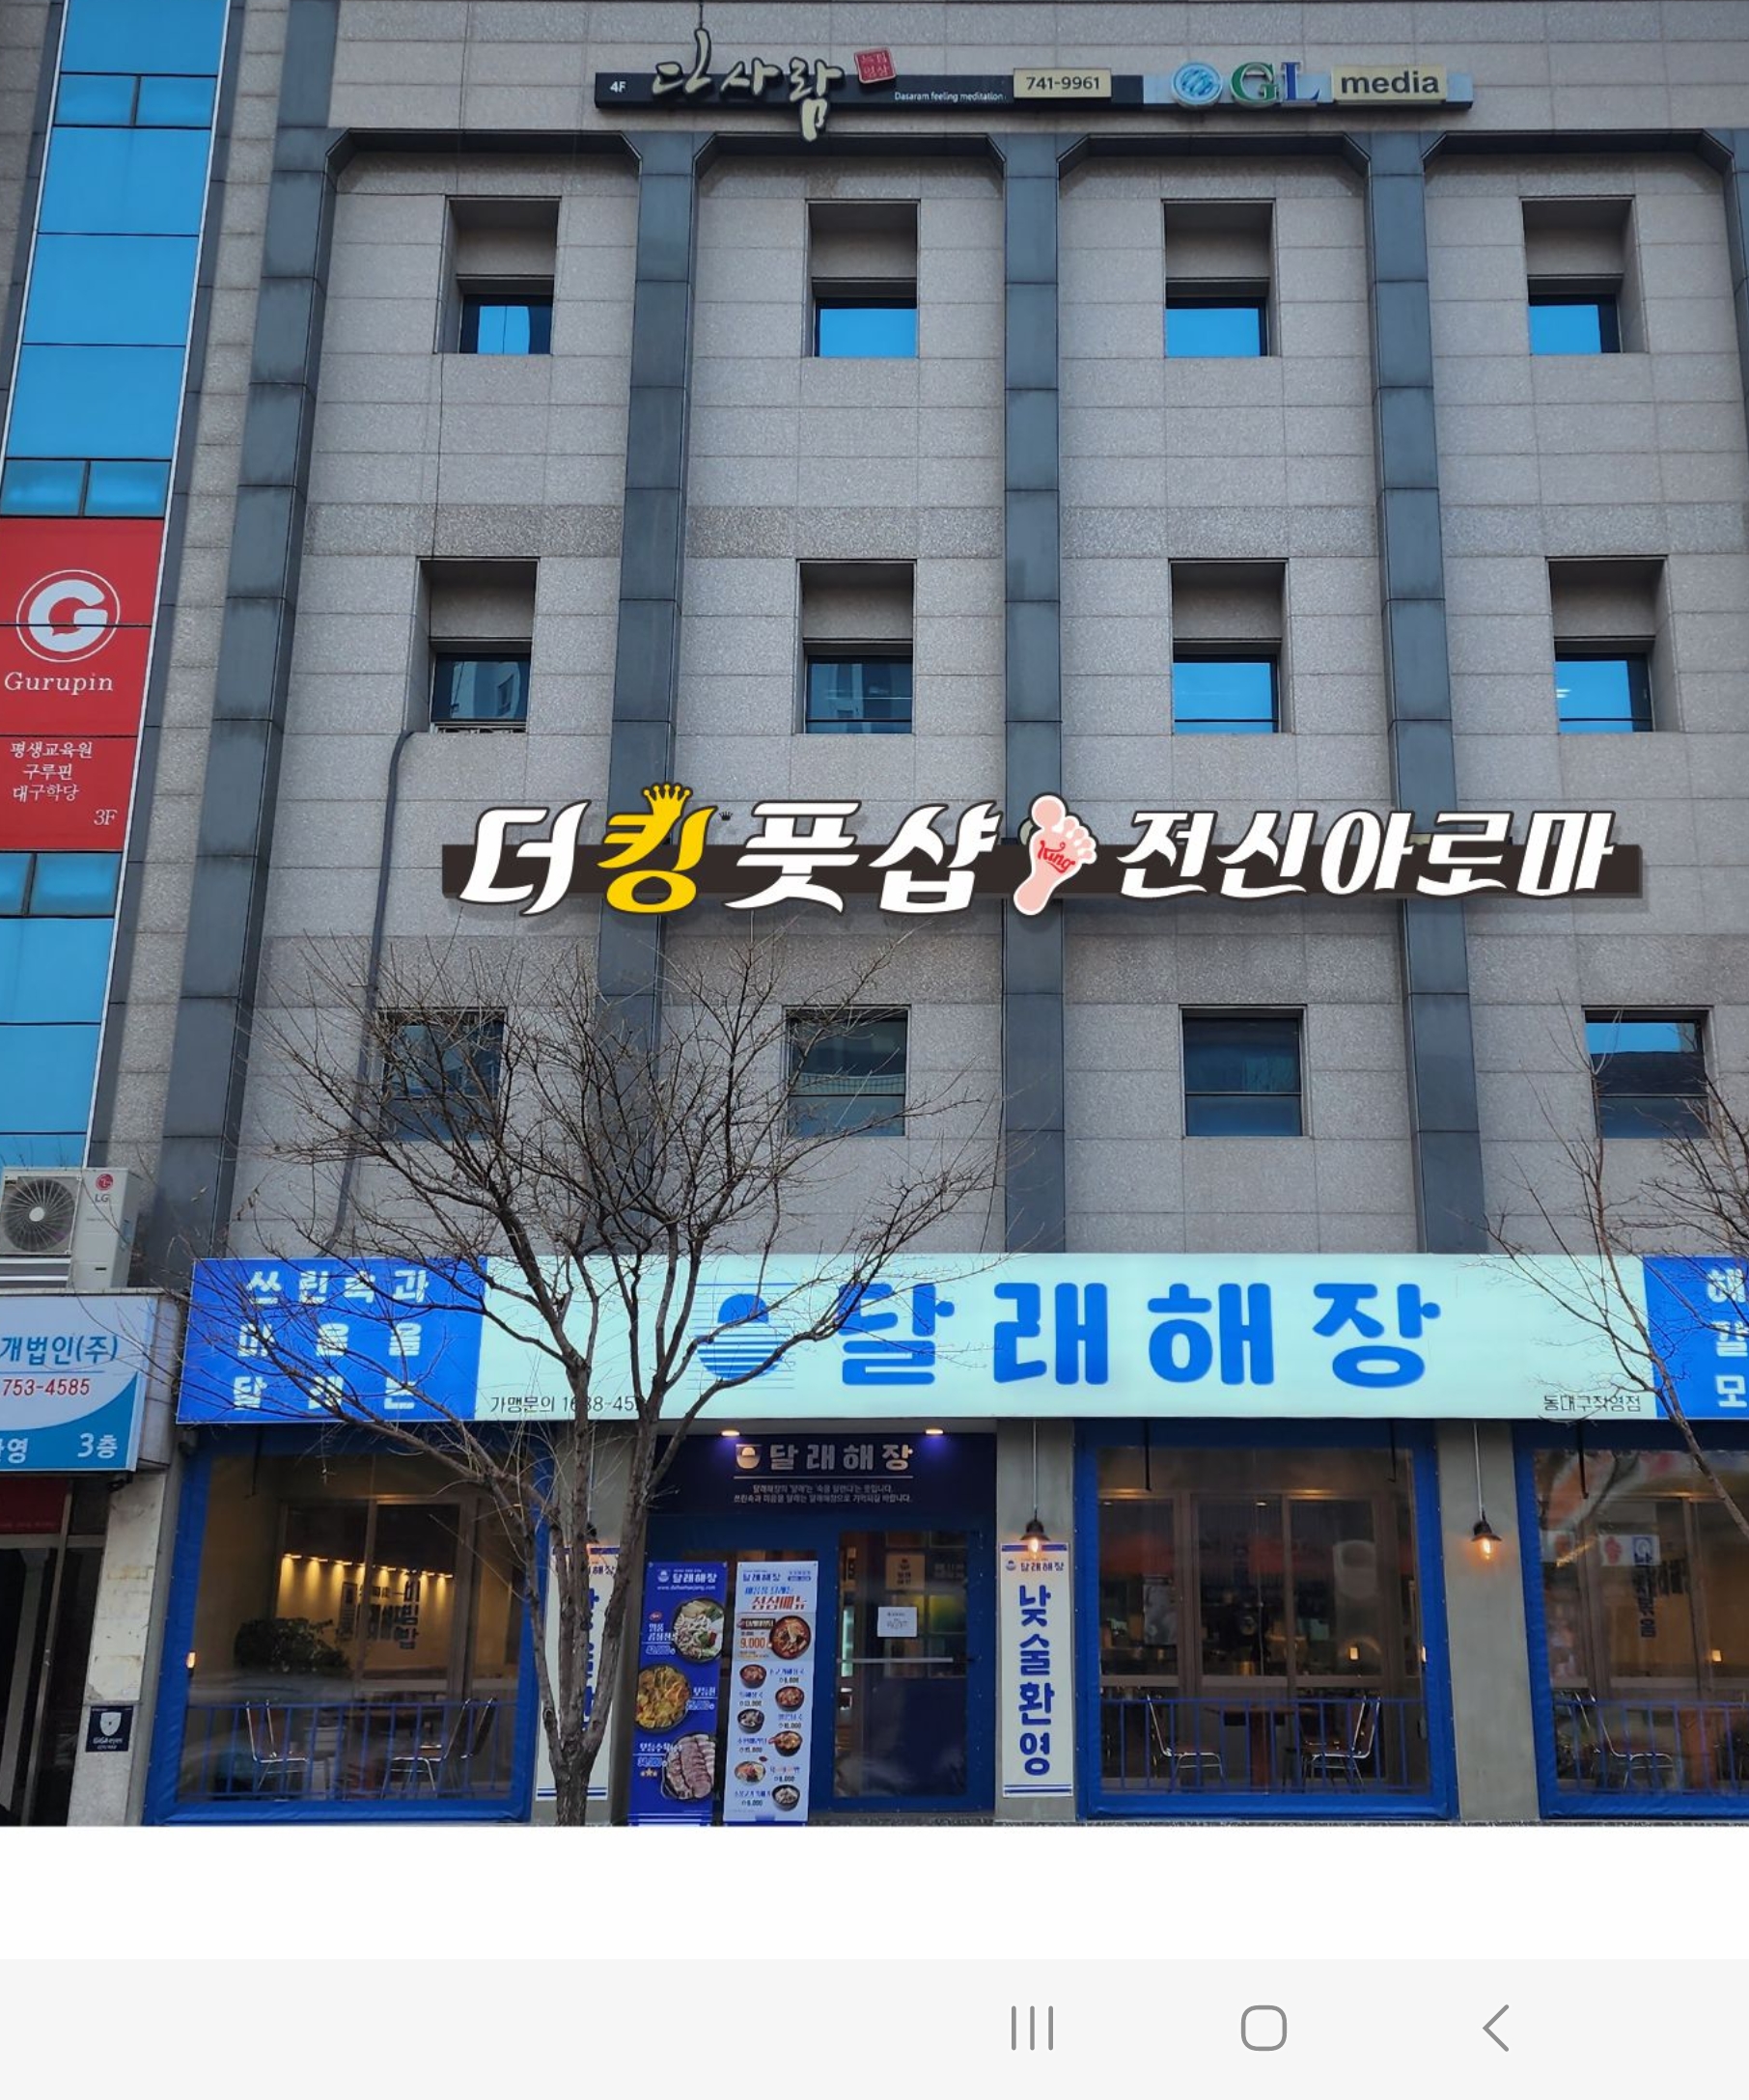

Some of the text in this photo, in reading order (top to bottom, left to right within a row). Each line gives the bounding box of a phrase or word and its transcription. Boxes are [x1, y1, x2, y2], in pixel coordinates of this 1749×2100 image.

[609, 81, 626, 93] 4F
[652, 28, 845, 141] 다사람
[1025, 75, 1100, 91] 741-9961
[1231, 61, 1321, 104] GL
[1341, 69, 1440, 95] media
[894, 92, 930, 100] Dasaram
[930, 92, 958, 102] feeling
[4, 672, 114, 695] Gurupin
[10, 741, 94, 759] 평생교육원
[22, 763, 73, 780] 구루핀
[13, 784, 80, 803] 대구학당
[94, 809, 118, 825] 3F
[458, 781, 1005, 918] 더킹풋샵
[1116, 809, 1617, 898] 전신아로마
[95, 1193, 110, 1202] LG
[837, 1281, 1442, 1389] 달래해장
[0, 1336, 118, 1366] 개법인(주)
[3, 1378, 91, 1395] 753-4585
[489, 1395, 556, 1413] 가맹문의
[77, 1432, 118, 1459] 3층
[769, 1444, 914, 1471] 달래해장
[1020, 1561, 1065, 1572] 달래해장
[673, 1573, 718, 1584] 달래해장
[742, 1573, 781, 1583] 달래해장
[1018, 1585, 1055, 1776] 낮술환영
